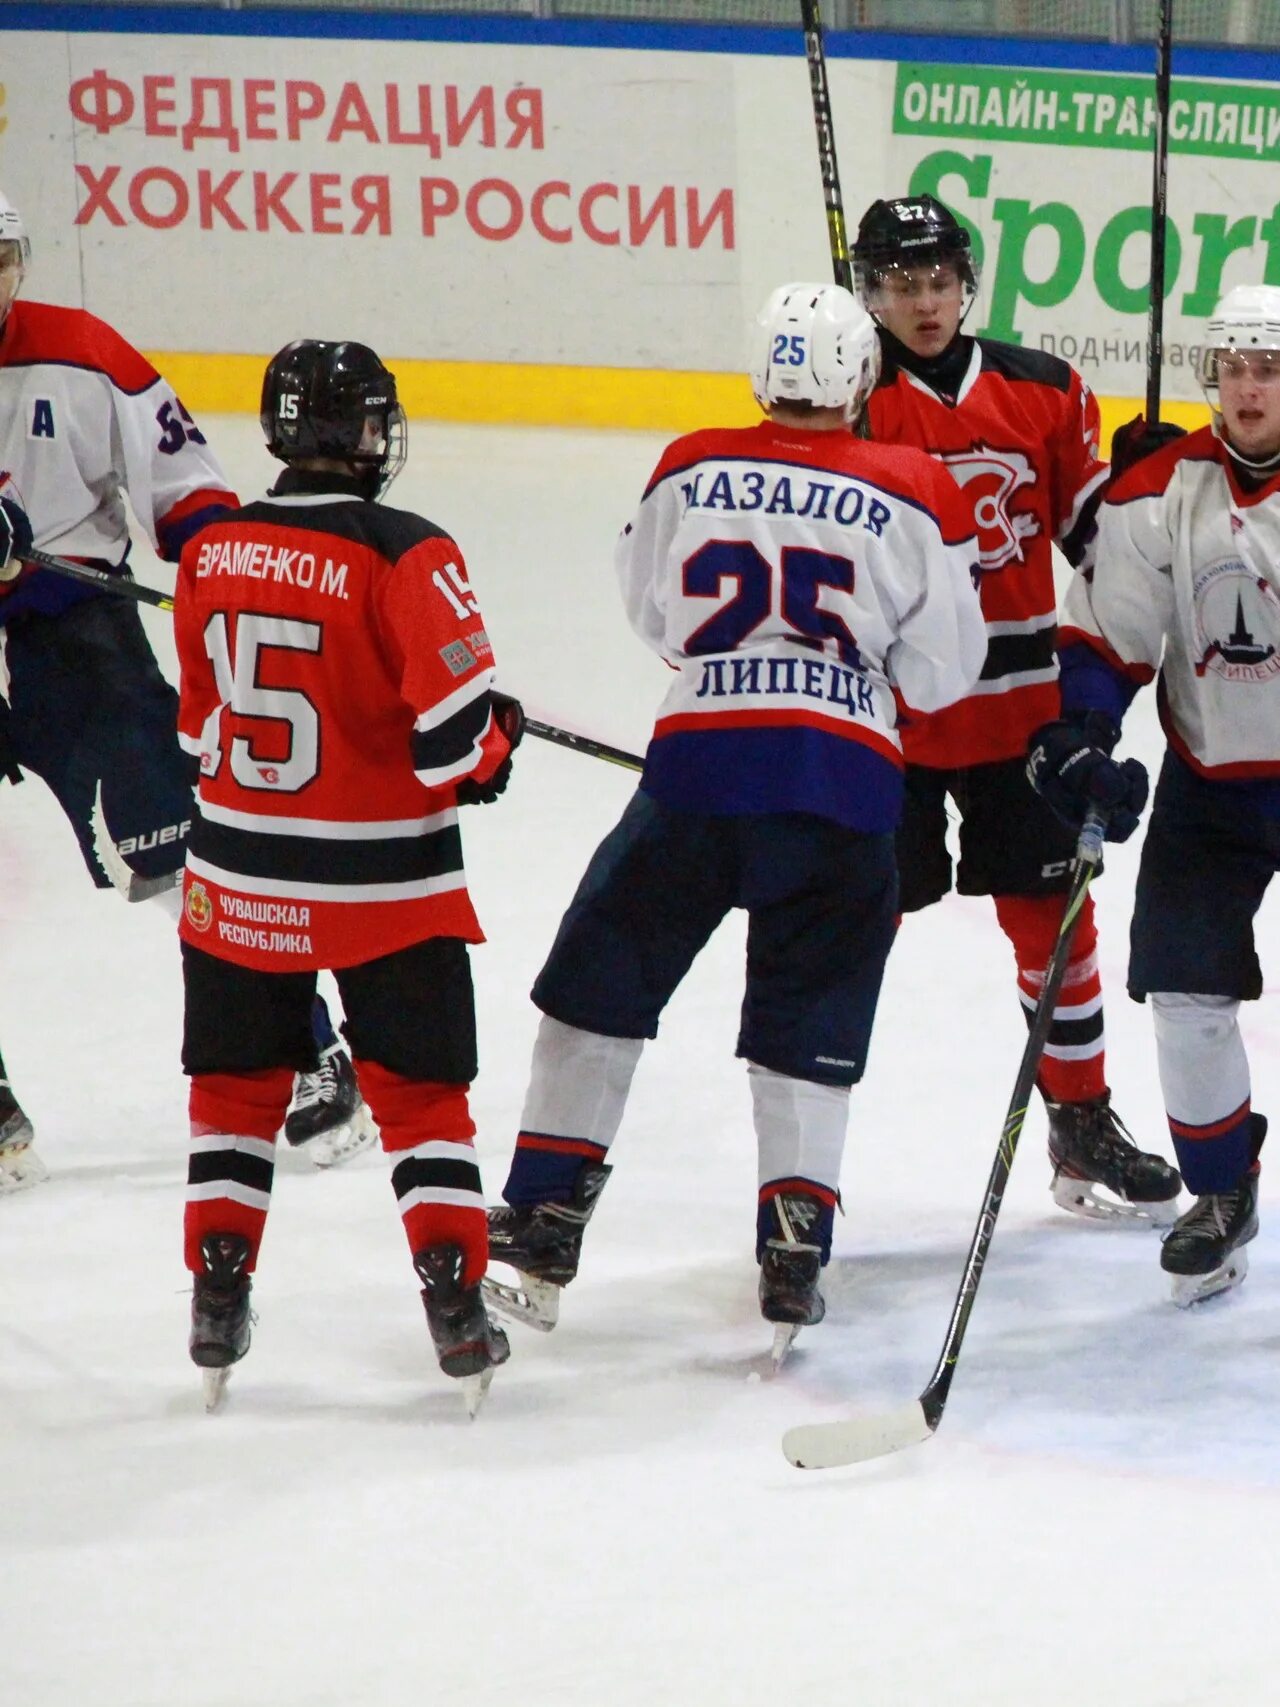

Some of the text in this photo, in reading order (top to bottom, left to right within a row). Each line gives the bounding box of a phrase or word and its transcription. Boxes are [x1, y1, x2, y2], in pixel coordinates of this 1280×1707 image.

[69, 69, 545, 158] ФЕДЕРАЦИЯ
[74, 164, 736, 251] ХОККЕЯ РОССИИ
[893, 204, 925, 222] 27
[772, 334, 805, 366] 25
[279, 393, 299, 419] 15
[364, 396, 387, 406] CCM
[319, 559, 349, 600] М.
[432, 562, 482, 620] 15
[681, 538, 868, 672] 25
[200, 609, 323, 795] 15
[696, 657, 876, 719] ЛИПЕЦК
[219, 893, 310, 928] ЧУВАШСКАЯ
[218, 920, 313, 955] РЕСПУБЛИКА
